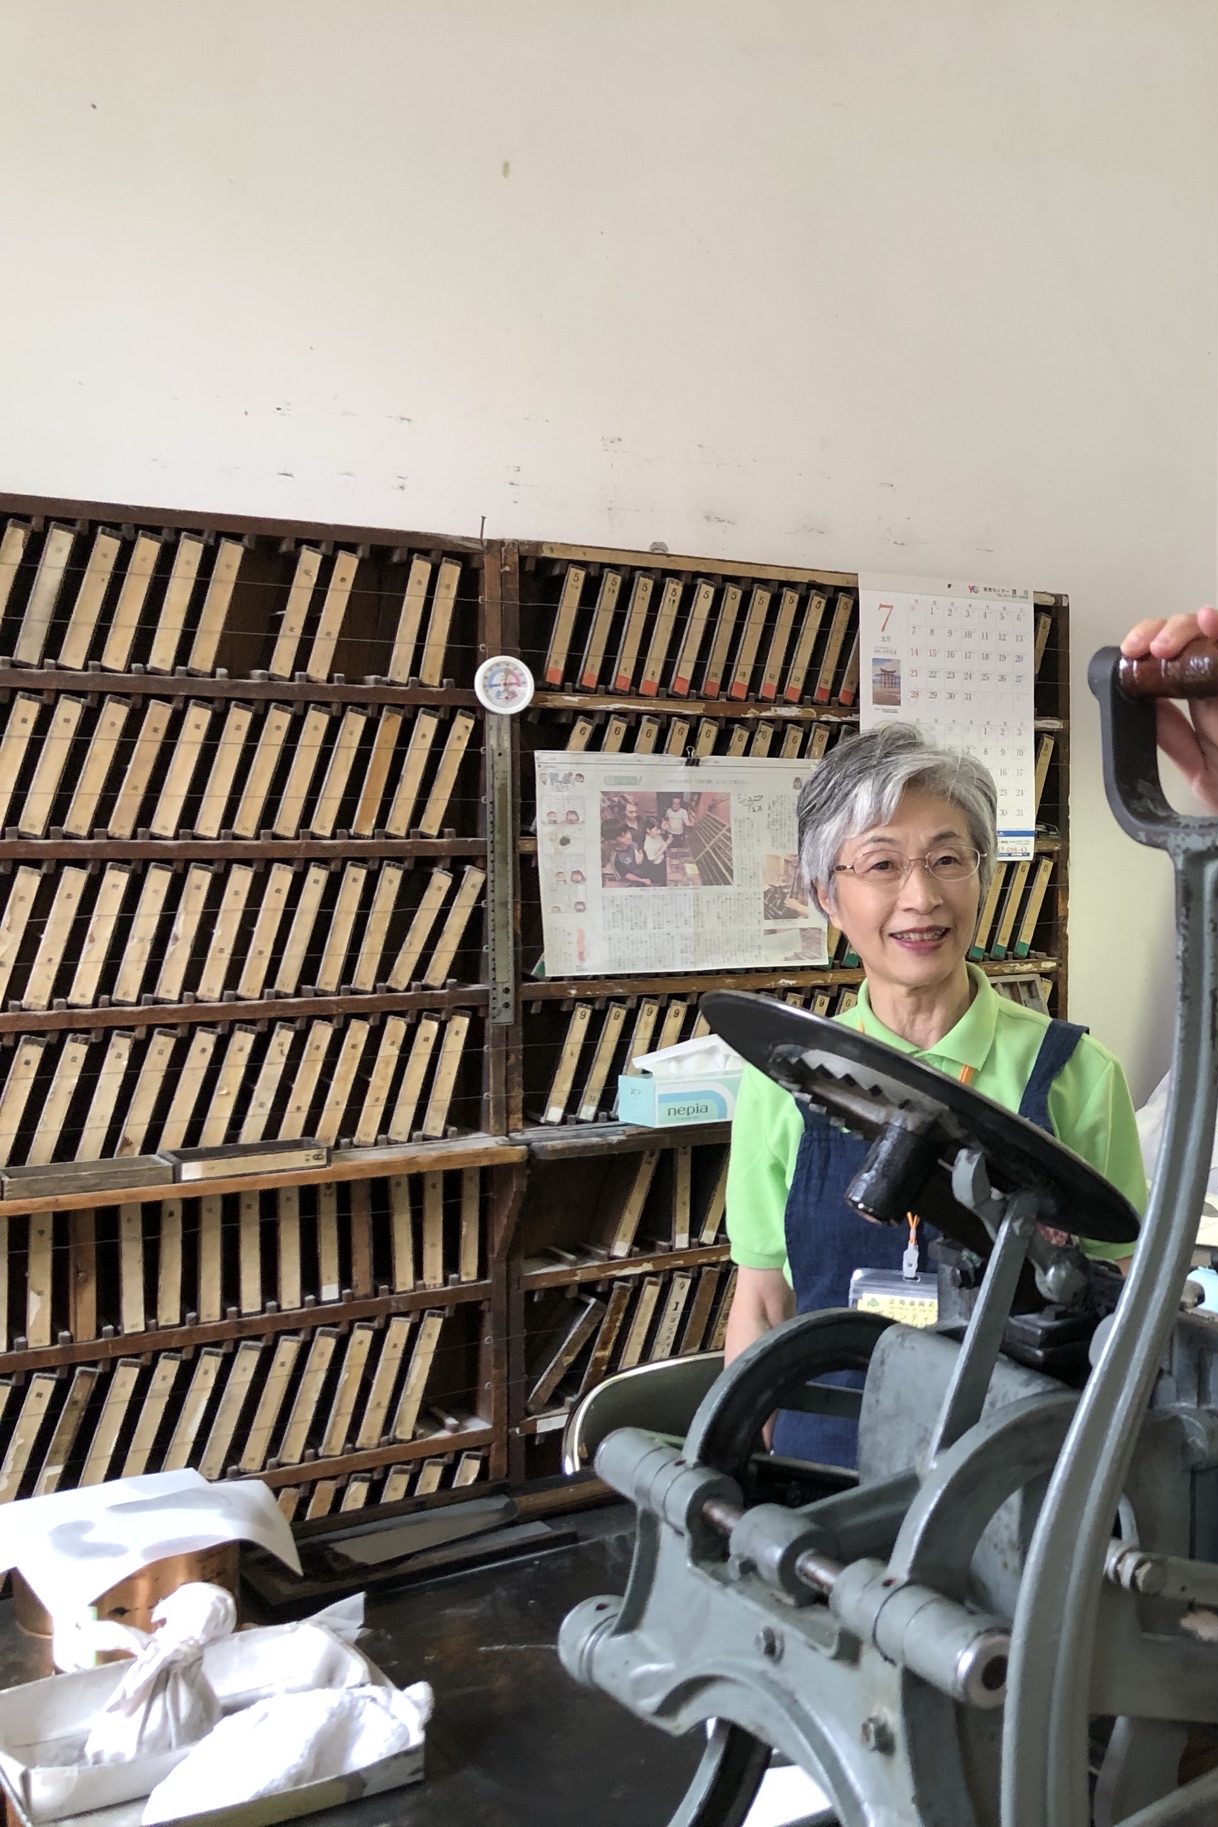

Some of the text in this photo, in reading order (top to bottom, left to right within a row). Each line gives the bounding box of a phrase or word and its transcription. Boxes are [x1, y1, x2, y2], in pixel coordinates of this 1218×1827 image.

[573, 573, 580, 582] 5
[611, 577, 617, 587] 5
[641, 583, 648, 592] 5
[671, 588, 677, 597] 5
[703, 590, 710, 600] 5
[731, 591, 737, 601] 5
[788, 595, 795, 605] 5
[758, 596, 764, 606] 5
[877, 603, 894, 633] 7
[930, 607, 934, 615] 1
[947, 608, 953, 617] 2
[965, 610, 970, 618] 3
[1000, 612, 1005, 621] 5
[911, 626, 1023, 643] 7 8 9 10 11 12 13
[910, 648, 1024, 663] 14 15 16 17 18 19 20
[910, 669, 918, 677] 21
[928, 670, 937, 678] 22
[946, 671, 955, 679] 23
[980, 673, 990, 681] 25
[998, 674, 1007, 682] 26
[1014, 675, 1023, 683] 27
[910, 690, 972, 701] 28 29 30 31
[579, 727, 587, 736] 6
[614, 726, 621, 736] 6
[645, 729, 652, 738] 6
[677, 727, 684, 736] 6
[705, 729, 711, 738] 6
[760, 730, 767, 739] 6
[1016, 728, 1022, 736] 3
[738, 733, 744, 742] 6
[791, 735, 798, 744] 6
[818, 733, 824, 742] 6
[1000, 748, 1005, 756] 9
[1016, 748, 1024, 756] 10
[1016, 809, 1024, 817] 31
[580, 1010, 587, 1020] 9
[613, 1010, 620, 1020] 9
[646, 1007, 653, 1016] 9
[673, 1008, 680, 1018] 9
[667, 1103, 708, 1117] nepia
